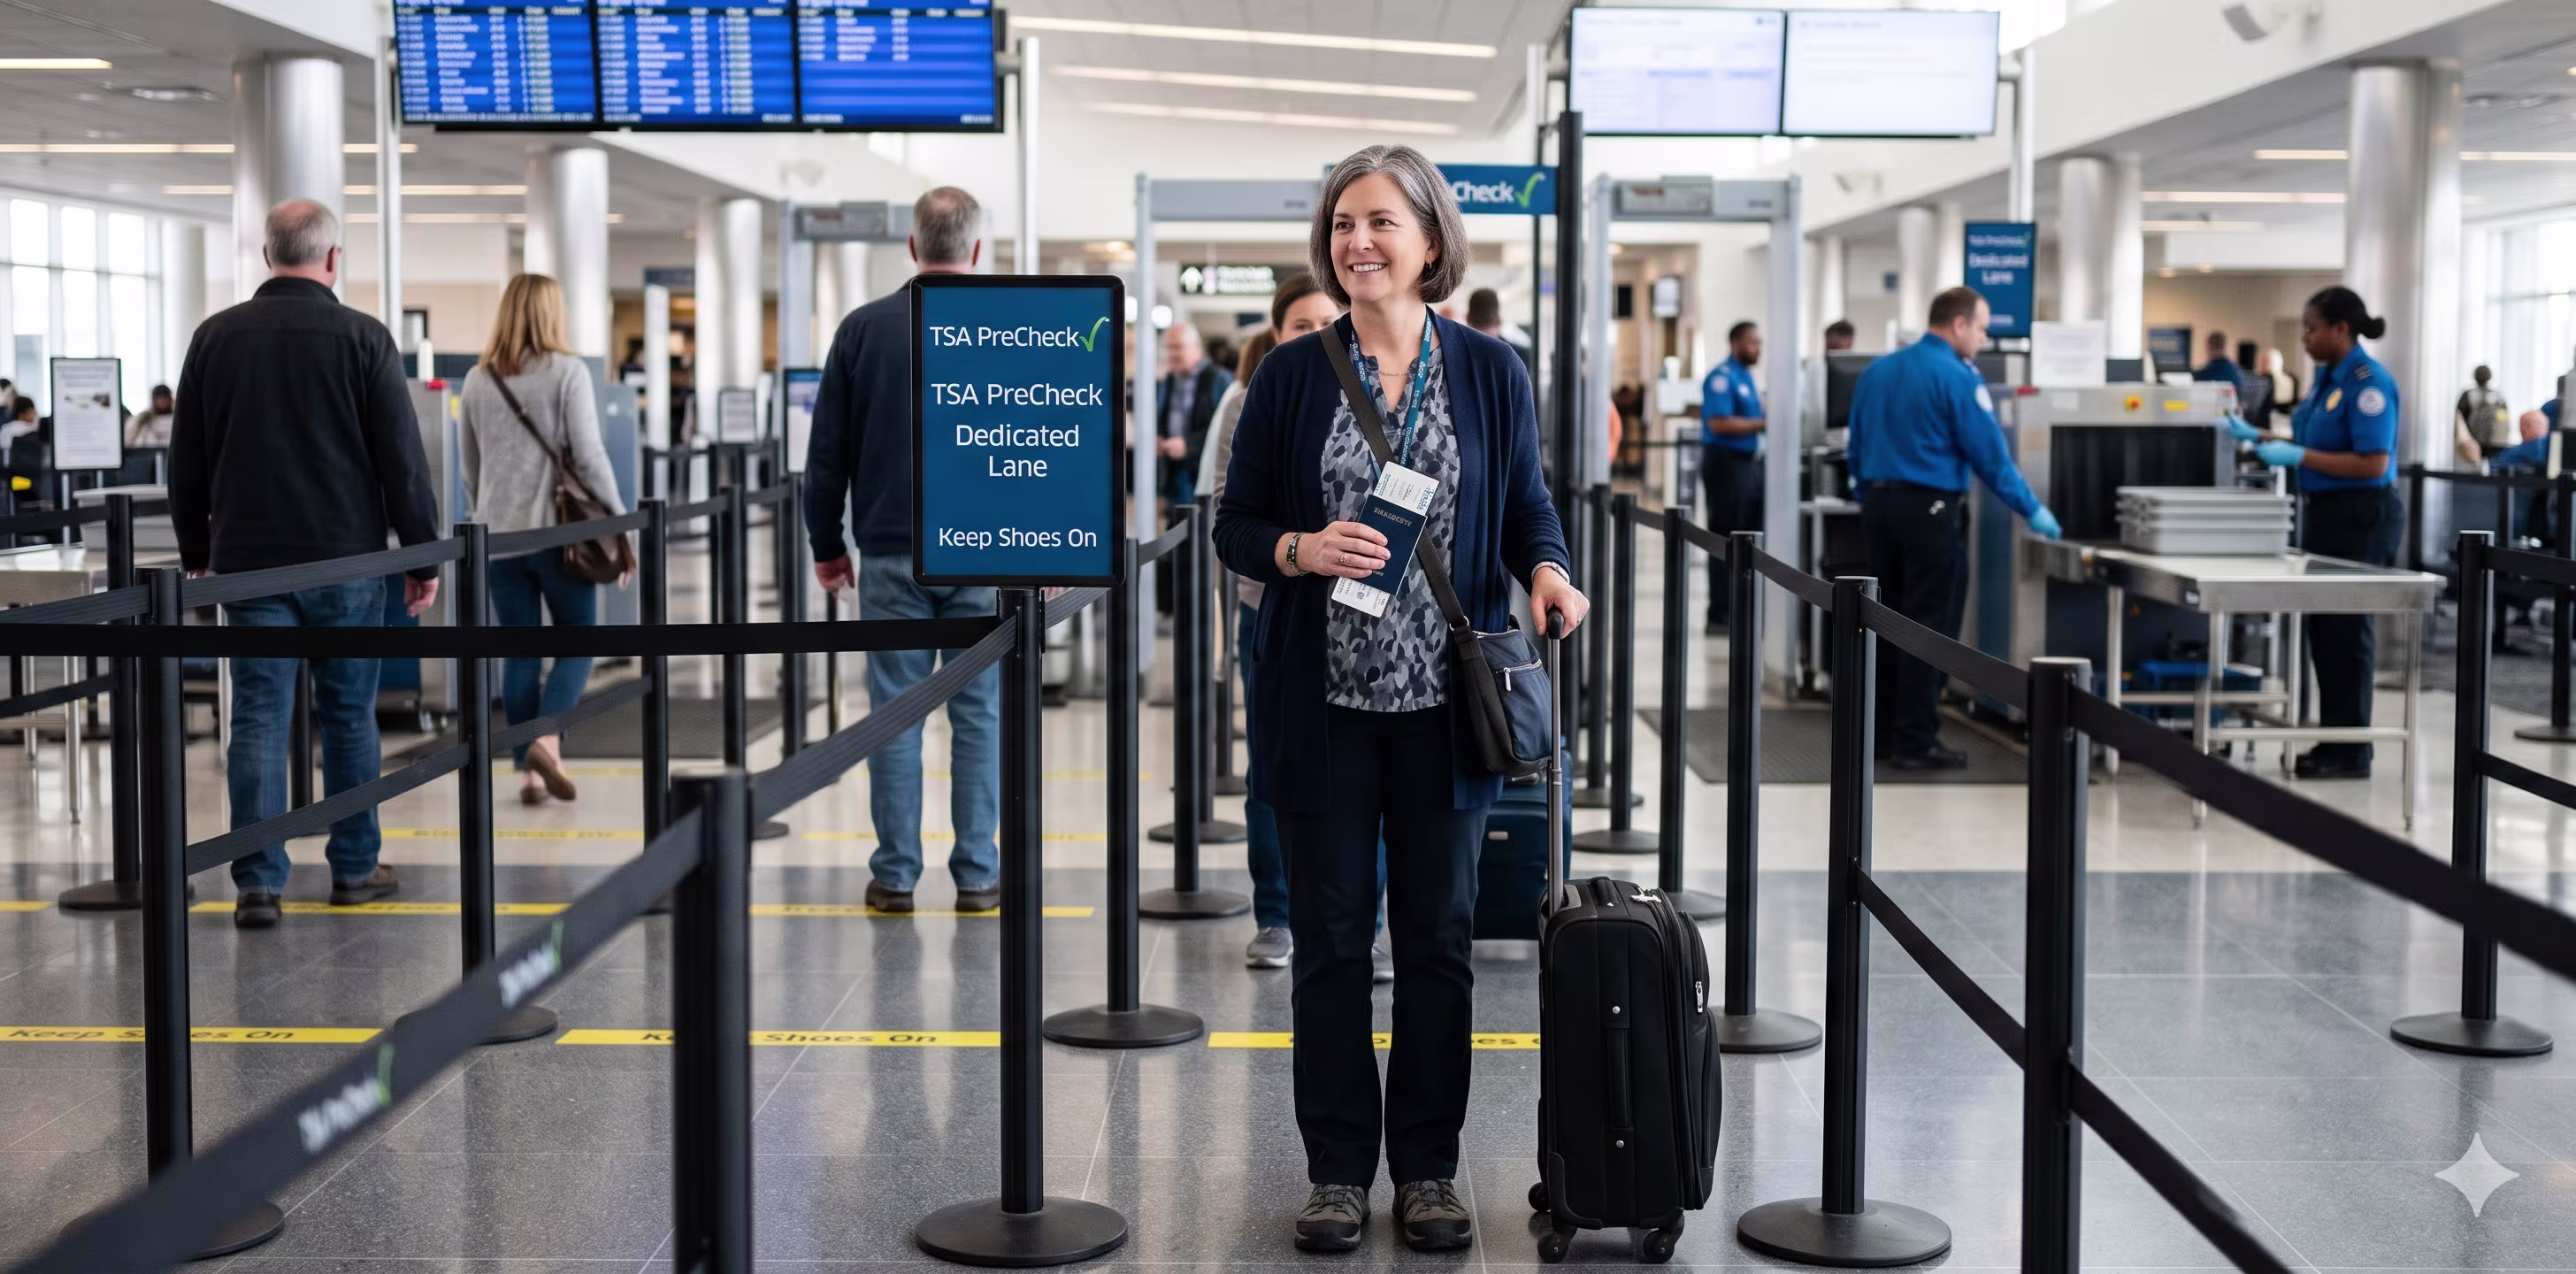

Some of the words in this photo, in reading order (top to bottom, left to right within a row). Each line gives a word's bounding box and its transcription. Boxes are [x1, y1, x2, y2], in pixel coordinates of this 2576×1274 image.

[930, 326, 972, 346] TSA
[978, 326, 1079, 347] PreCheck
[931, 383, 979, 405] TSA
[987, 384, 1103, 406] PreCheck
[956, 424, 1079, 447] Dedicated
[989, 456, 1047, 478] Lane
[939, 528, 992, 550] Keep
[999, 528, 1062, 548] Shoes
[1069, 529, 1097, 548] On
[9, 1029, 105, 1040] Keep
[245, 1031, 294, 1040] On
[763, 1032, 874, 1042] Shoes
[888, 1034, 937, 1043] On
